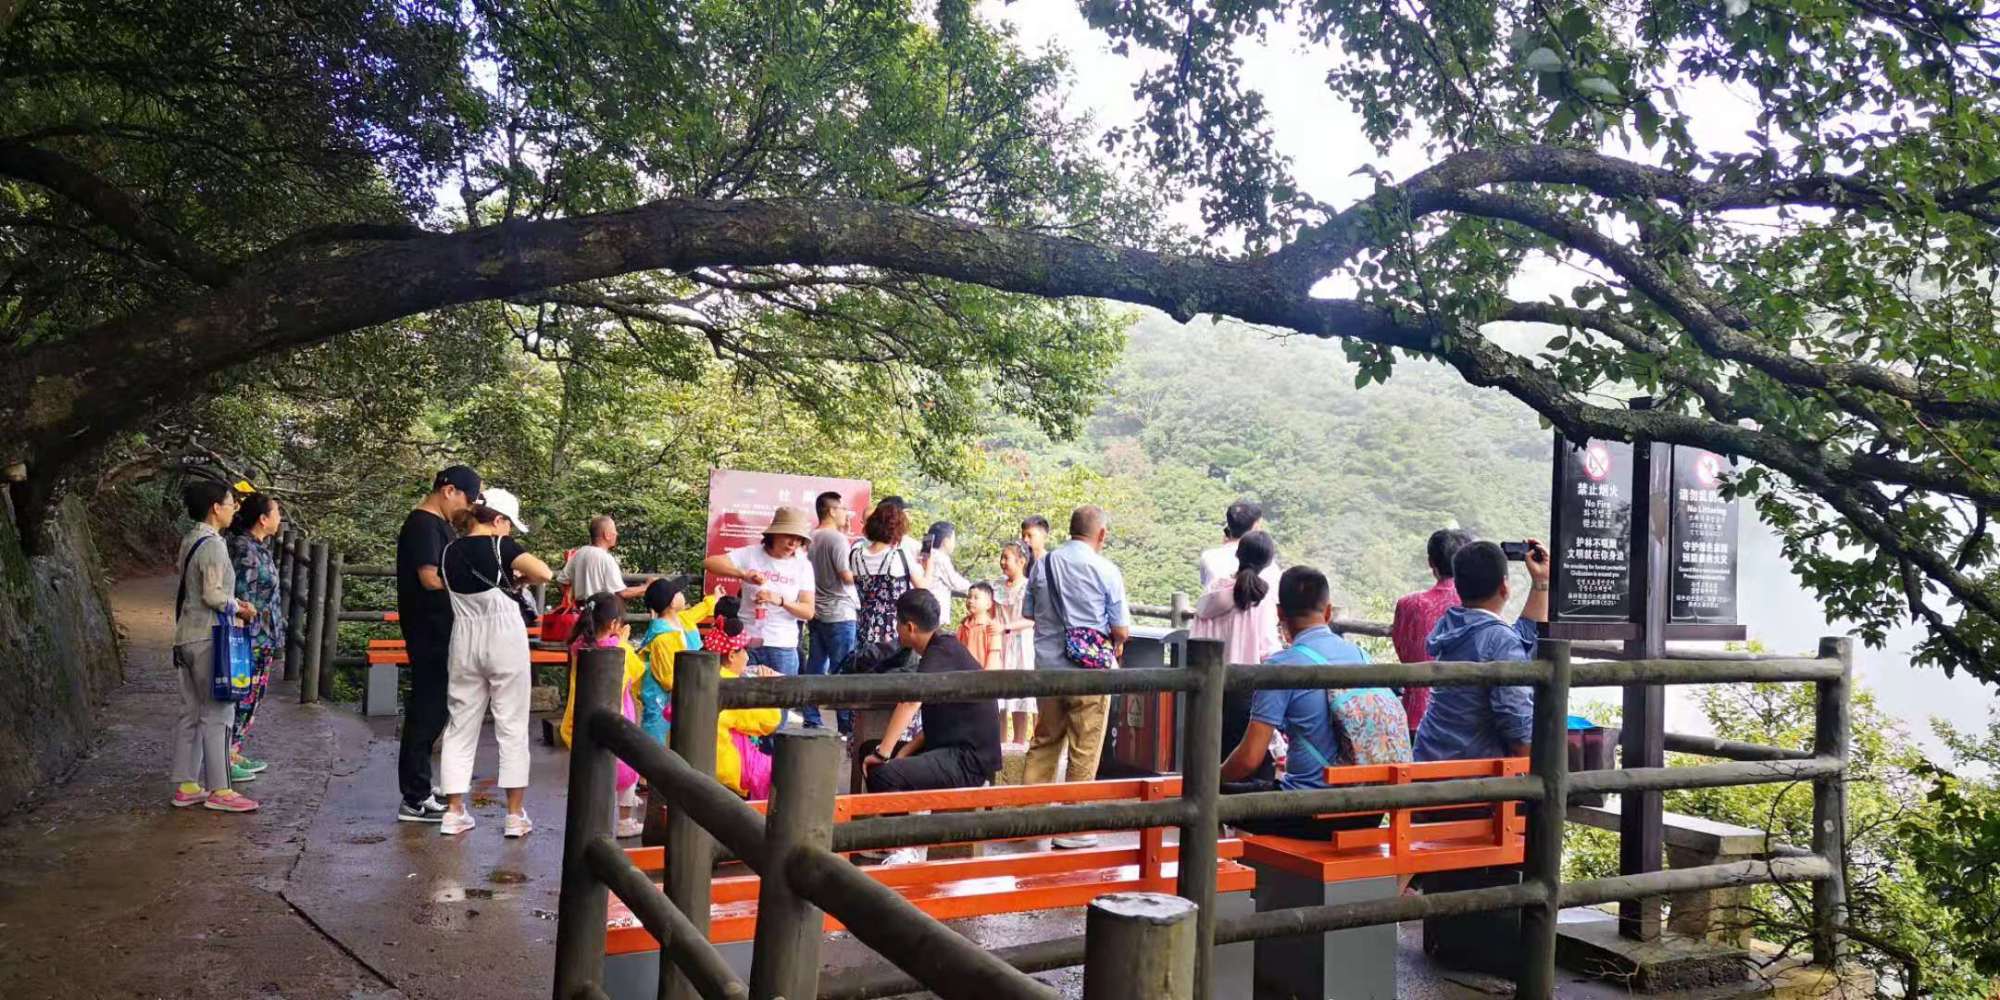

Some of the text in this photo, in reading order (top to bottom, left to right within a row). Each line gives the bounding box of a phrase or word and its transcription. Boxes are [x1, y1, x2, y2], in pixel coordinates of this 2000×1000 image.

[1577, 482, 1618, 497] 禁止烟火
[1679, 488, 1734, 504] 请勿乱扔
[1584, 499, 1611, 508] No Fire
[1687, 504, 1697, 513] No
[1567, 547, 1624, 561] 文明就在你身边
